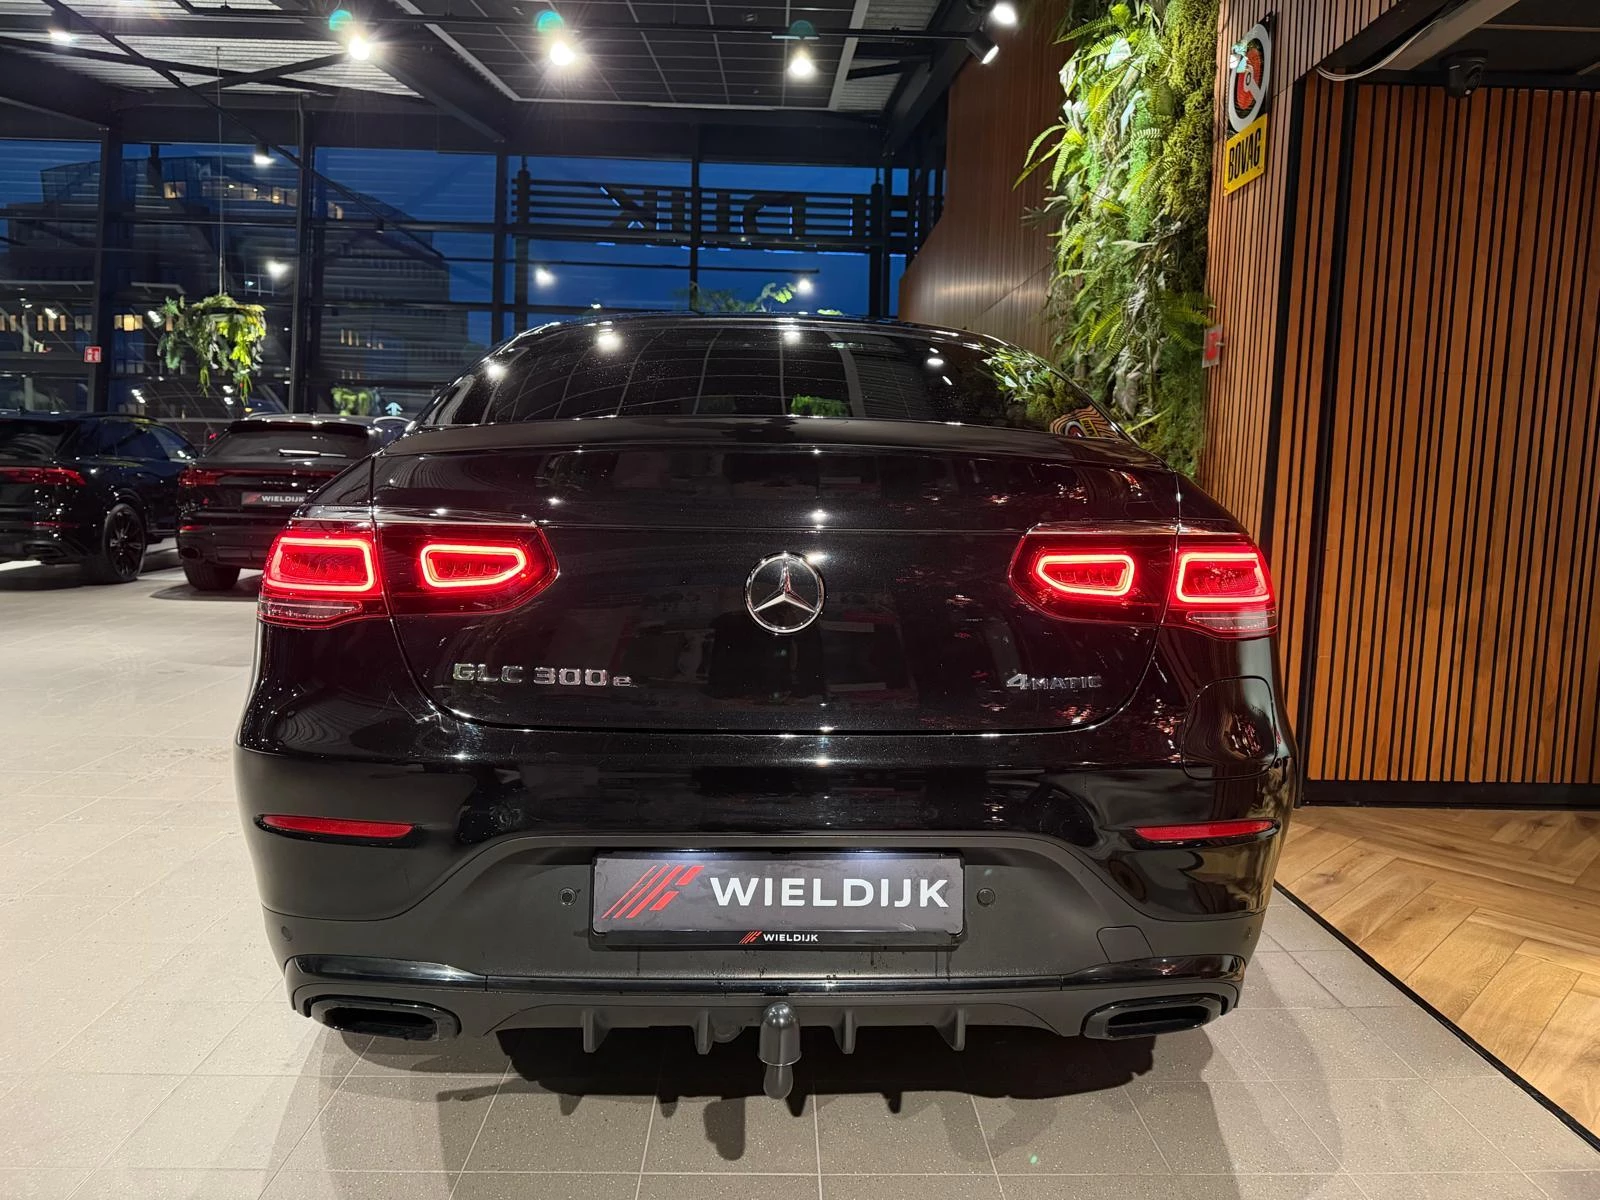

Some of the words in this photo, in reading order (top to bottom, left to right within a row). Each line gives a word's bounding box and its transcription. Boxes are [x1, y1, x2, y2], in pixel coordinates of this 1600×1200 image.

[1227, 127, 1262, 183] BOVAG
[452, 662, 524, 684] GLC
[1006, 673, 1102, 690] 4MATIC
[709, 877, 950, 908] WIELDIJK
[763, 933, 819, 942] WIELDIJK
